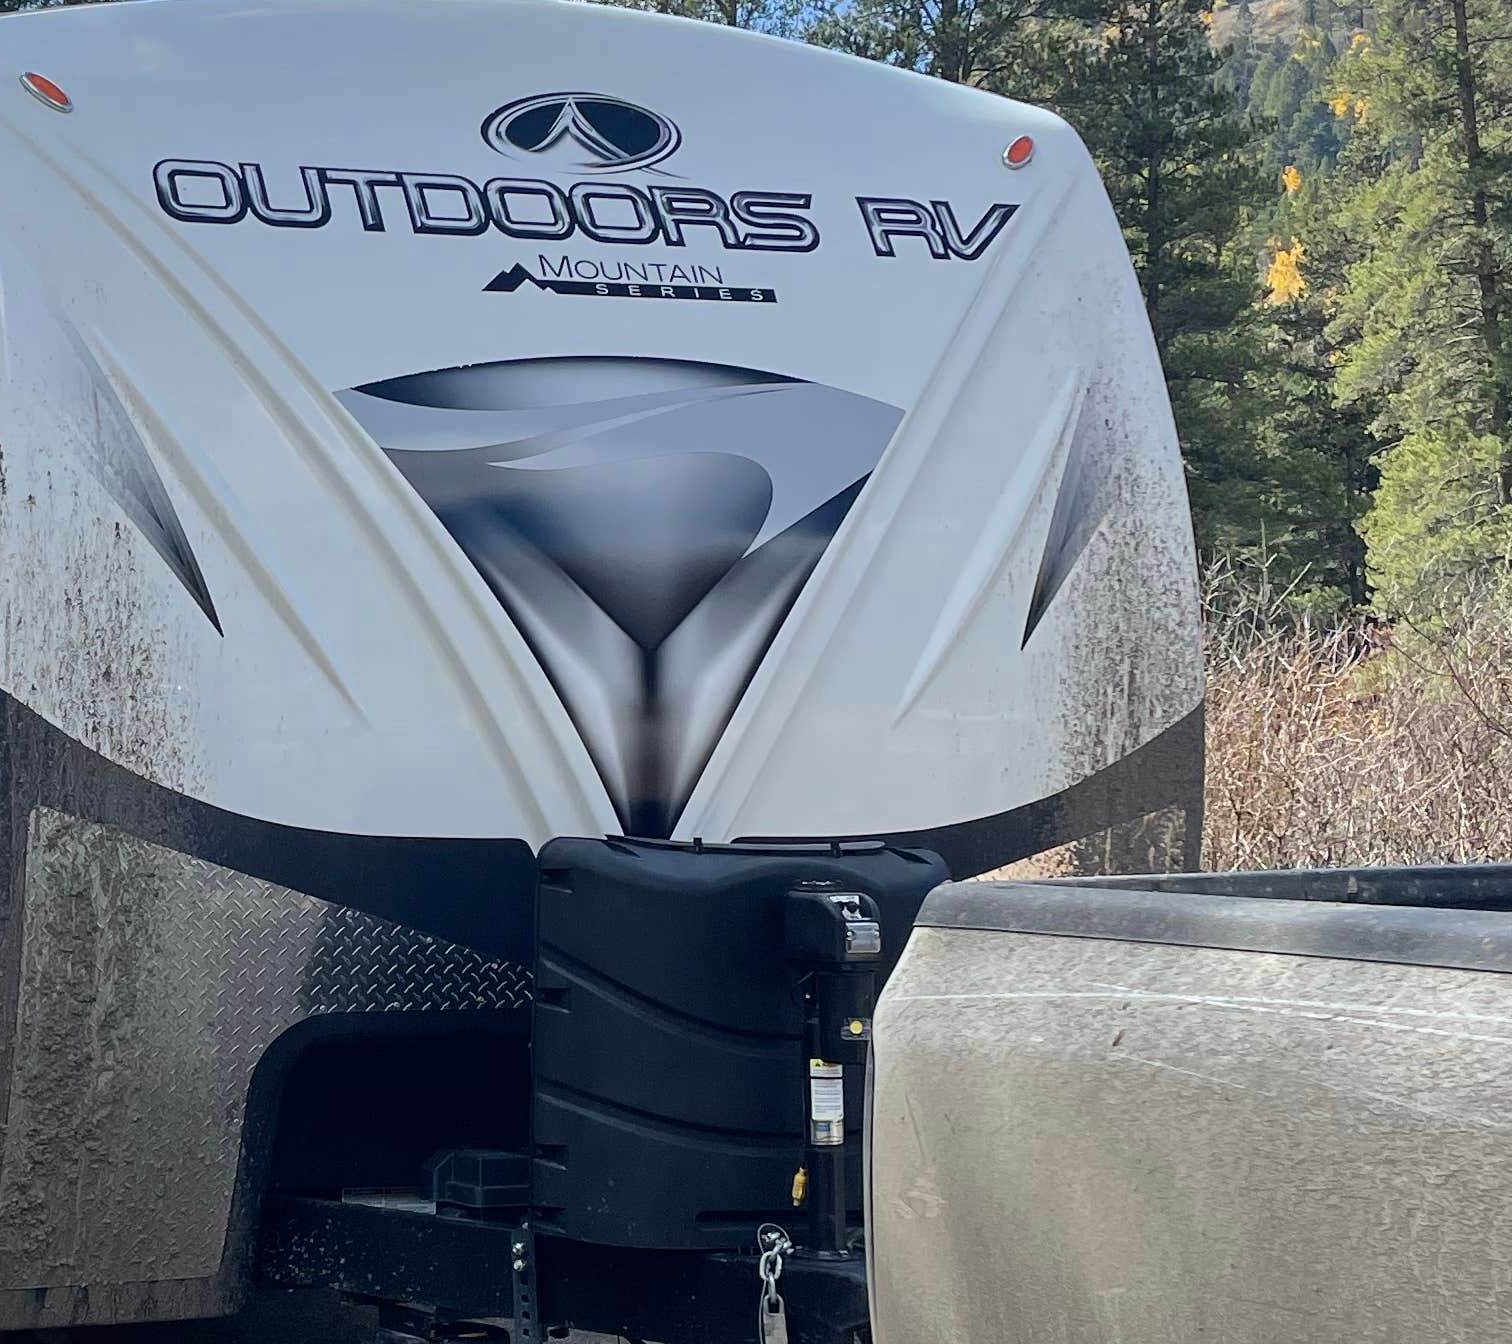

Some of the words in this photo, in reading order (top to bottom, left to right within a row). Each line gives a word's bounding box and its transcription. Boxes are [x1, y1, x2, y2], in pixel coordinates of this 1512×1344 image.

[152, 158, 821, 253] OUTDOORS
[855, 196, 1021, 260] RV
[594, 283, 764, 301] SERIES
